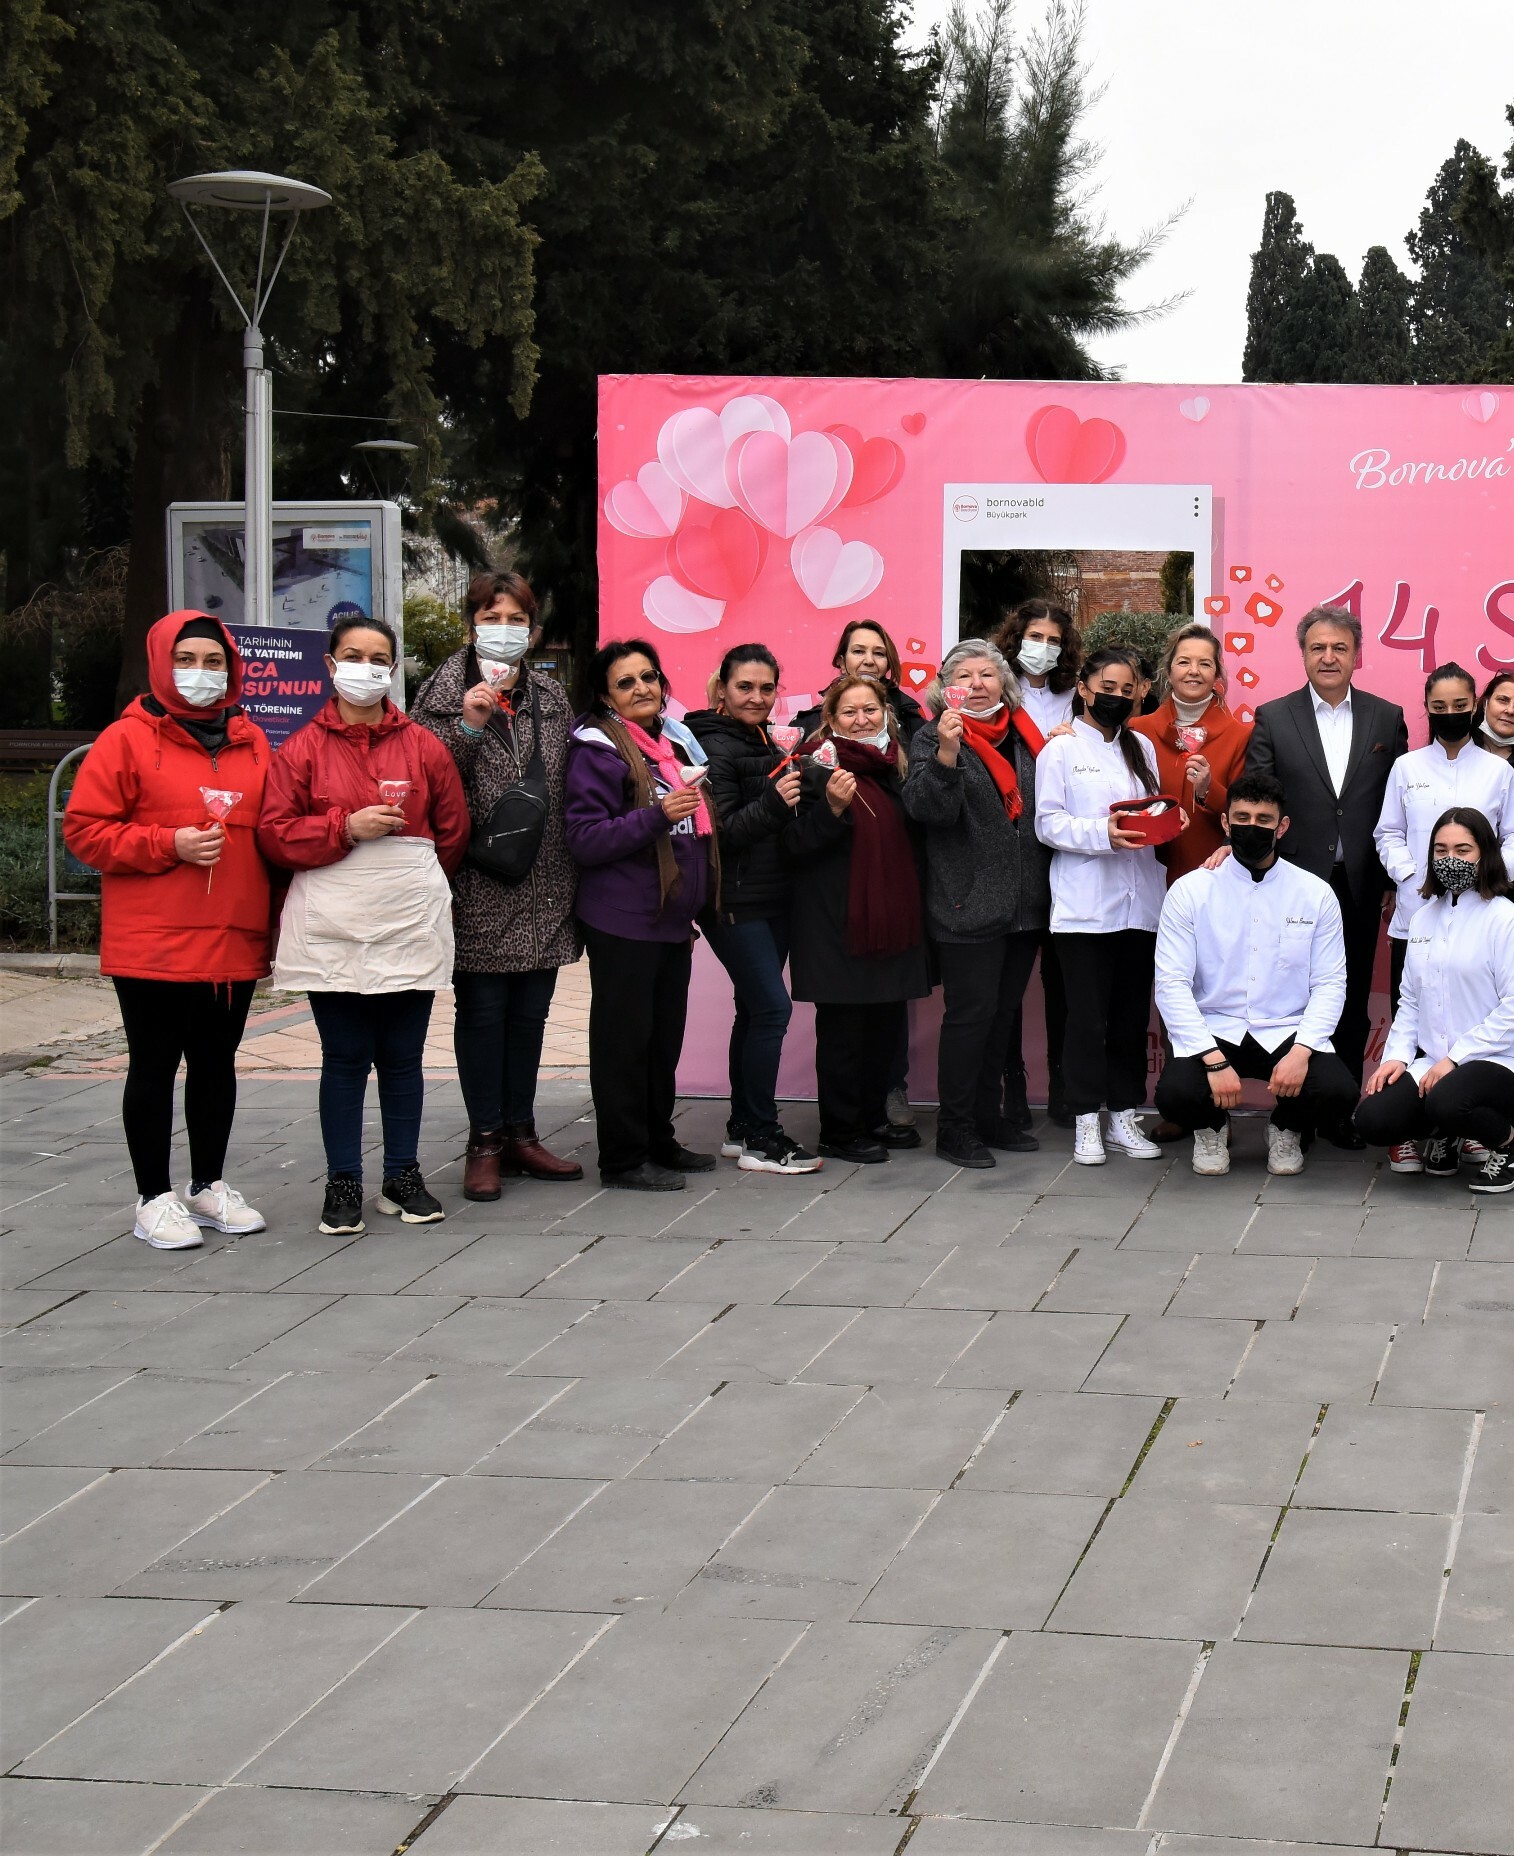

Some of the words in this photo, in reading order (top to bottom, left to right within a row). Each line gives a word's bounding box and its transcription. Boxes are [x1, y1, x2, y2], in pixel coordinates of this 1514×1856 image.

[986, 498, 1045, 507] bornovabld
[986, 511, 1028, 520] Büyükpark
[238, 636, 292, 648] TARİHİNİN
[254, 648, 303, 660] YATIRIMI
[241, 680, 322, 697] SU'NUN
[253, 703, 303, 715] TÖRENİNE
